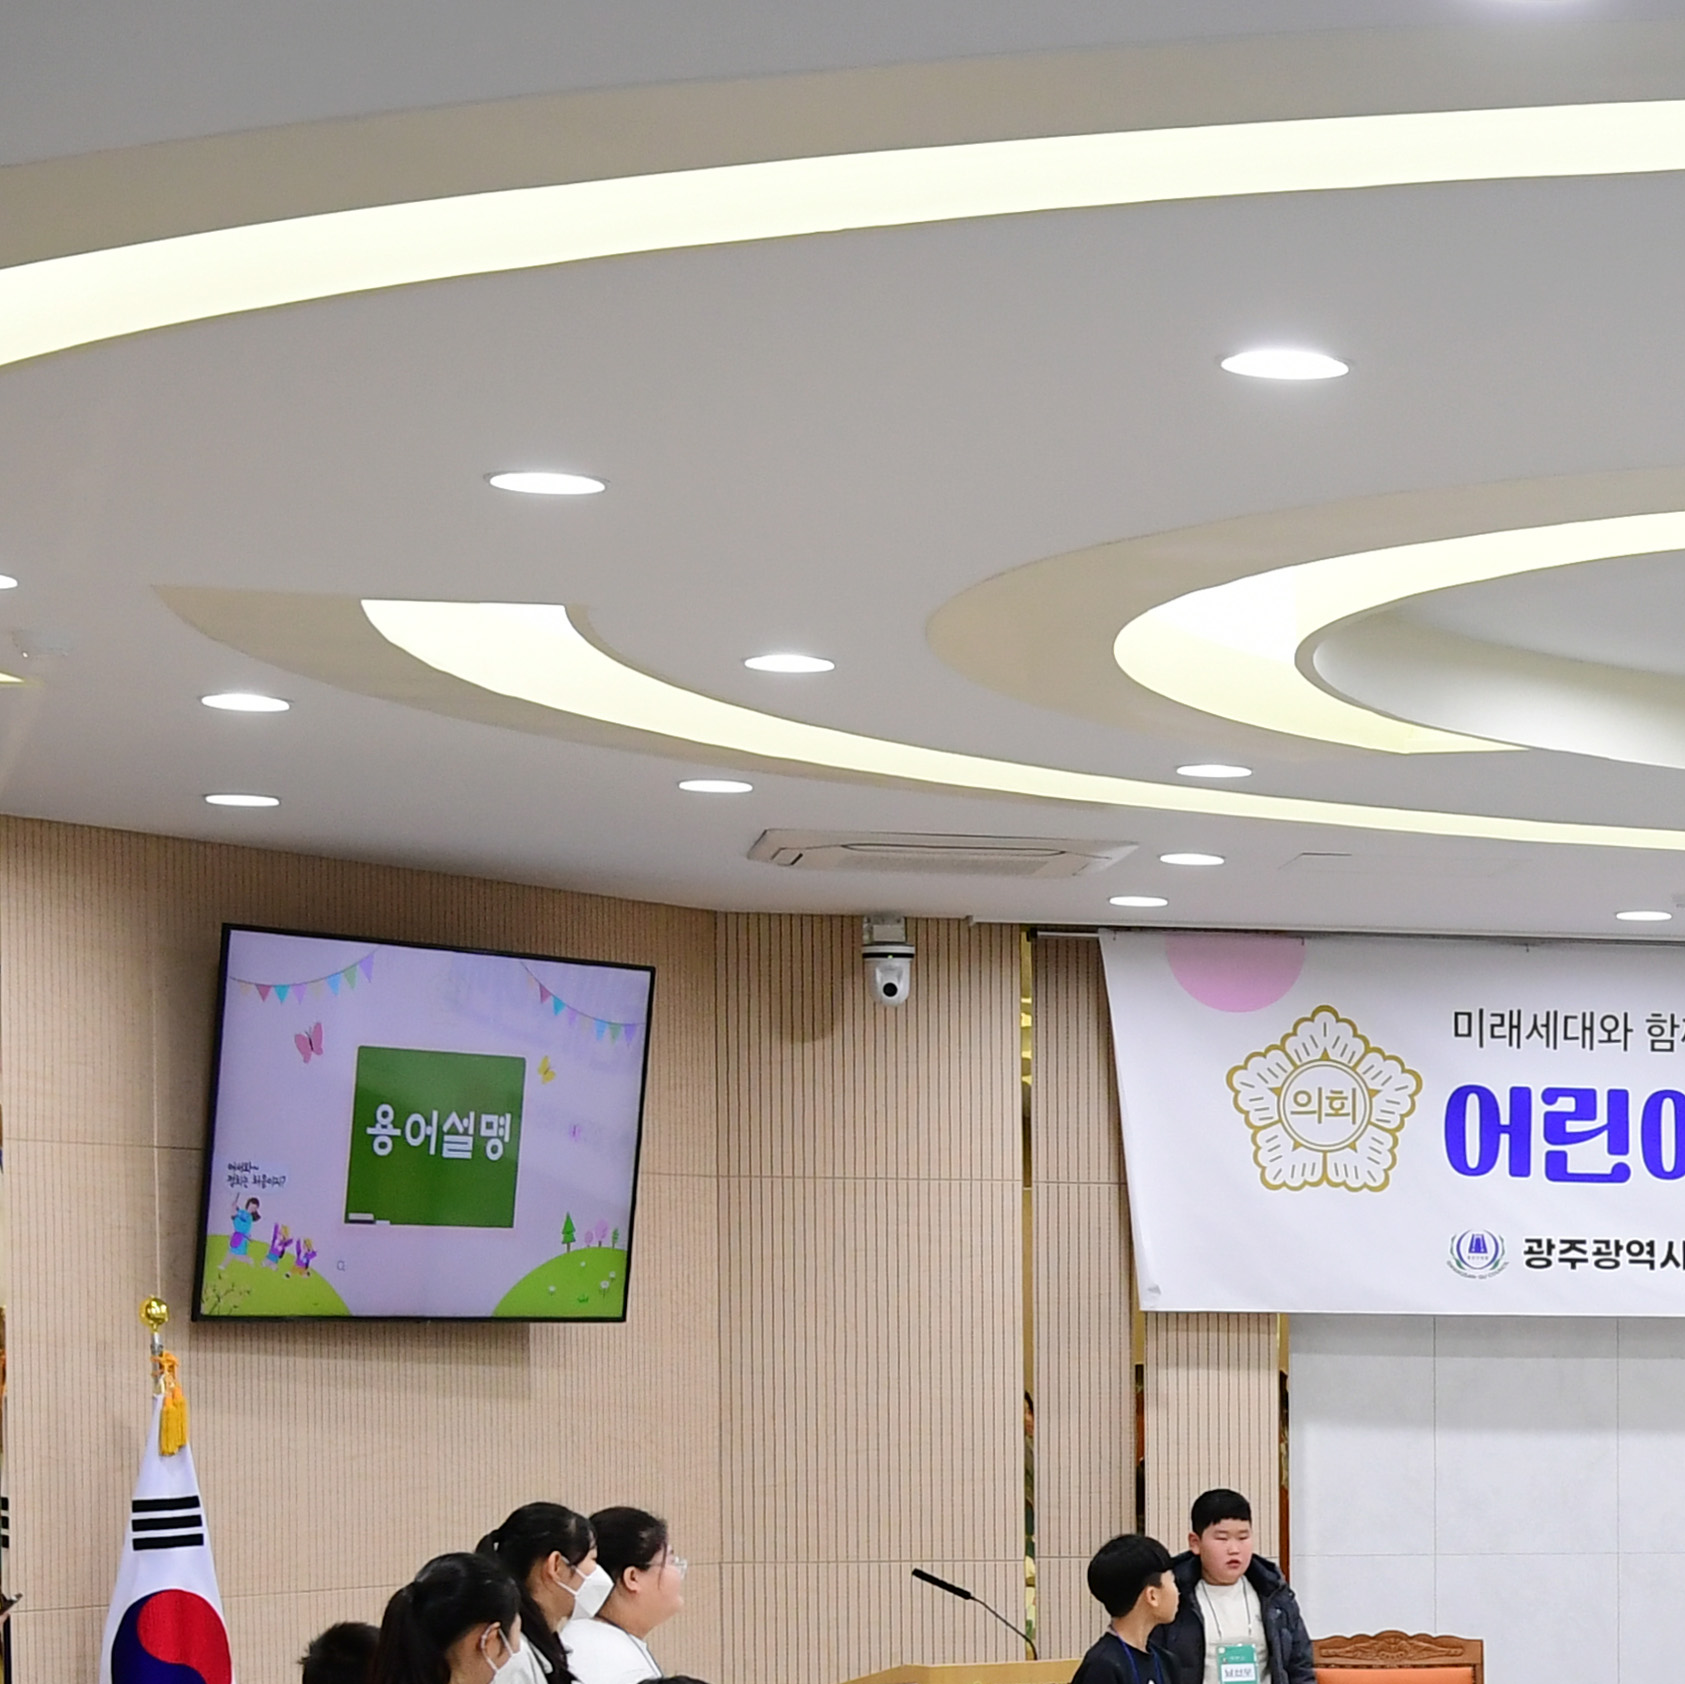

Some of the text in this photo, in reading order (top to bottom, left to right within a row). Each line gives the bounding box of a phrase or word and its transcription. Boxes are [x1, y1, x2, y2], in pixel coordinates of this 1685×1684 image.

[1453, 1009, 1634, 1052] 미래세대와
[1290, 1087, 1357, 1125] 의회
[366, 1103, 512, 1161] 용어설명
